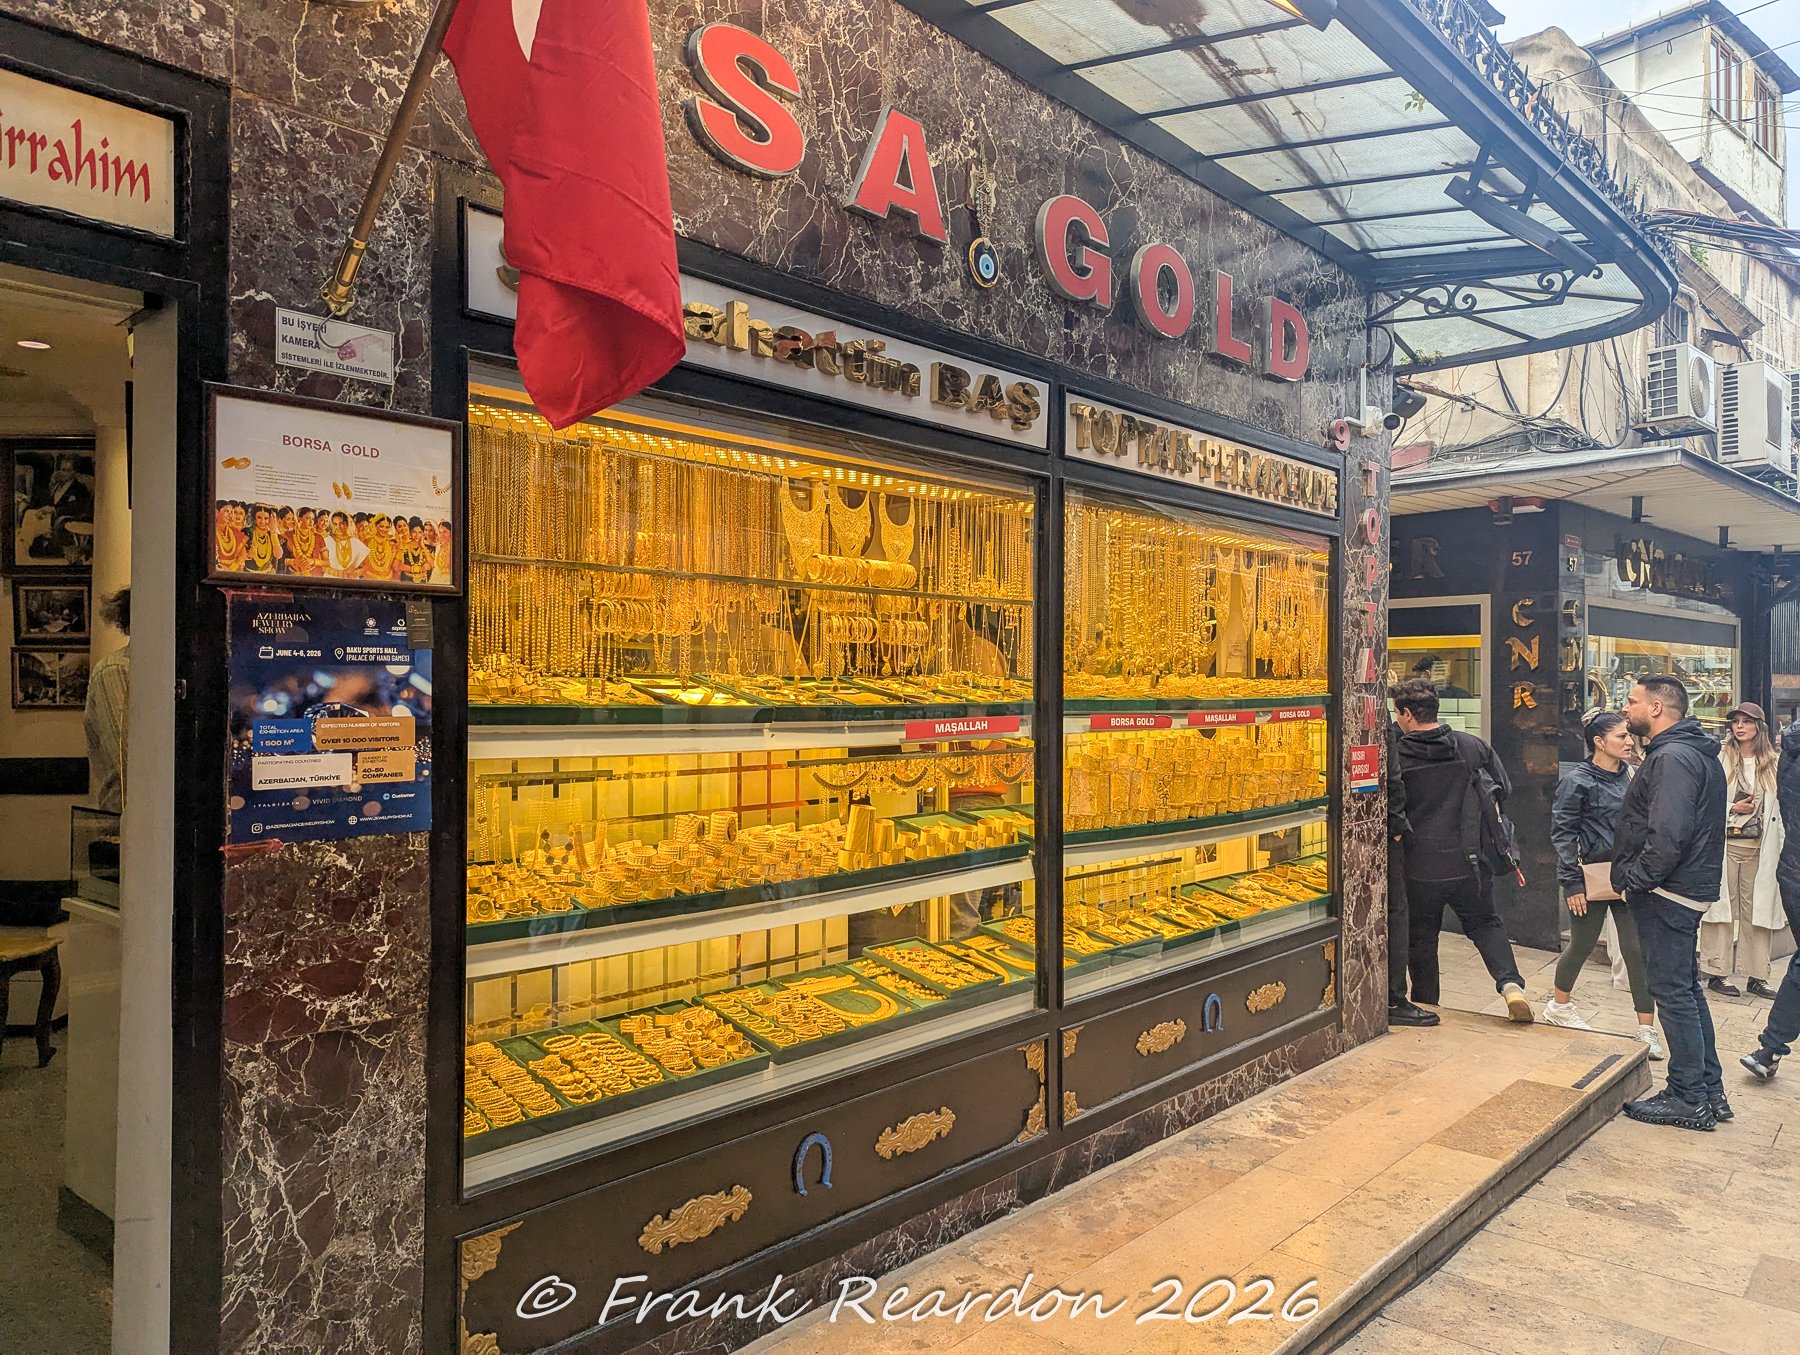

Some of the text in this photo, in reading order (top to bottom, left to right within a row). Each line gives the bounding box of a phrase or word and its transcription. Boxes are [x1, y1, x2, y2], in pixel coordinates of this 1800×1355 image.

[1035, 194, 1310, 382] GOLD
[282, 316, 294, 327] BU
[281, 334, 320, 350] KAMERA
[281, 352, 390, 379] SİSTEMLERİ İLE İZLENMEKTEDİR.
[930, 361, 1041, 431] BAŞ
[1330, 419, 1350, 451] 9
[282, 434, 380, 459] BORSA GOLD
[1511, 550, 1533, 566] 57
[1567, 557, 1578, 572] 57
[1358, 460, 1381, 731] TOPTAN
[257, 612, 312, 620] AZERBAIJAN
[252, 620, 293, 628] JEWELRY
[346, 654, 368, 662] (PALACE
[1204, 713, 1237, 724] MAŞALLAH
[1280, 709, 1310, 719] BORSA GOLD
[934, 720, 988, 735] MAŞALLAH
[1110, 716, 1155, 728] BORSA GOLD
